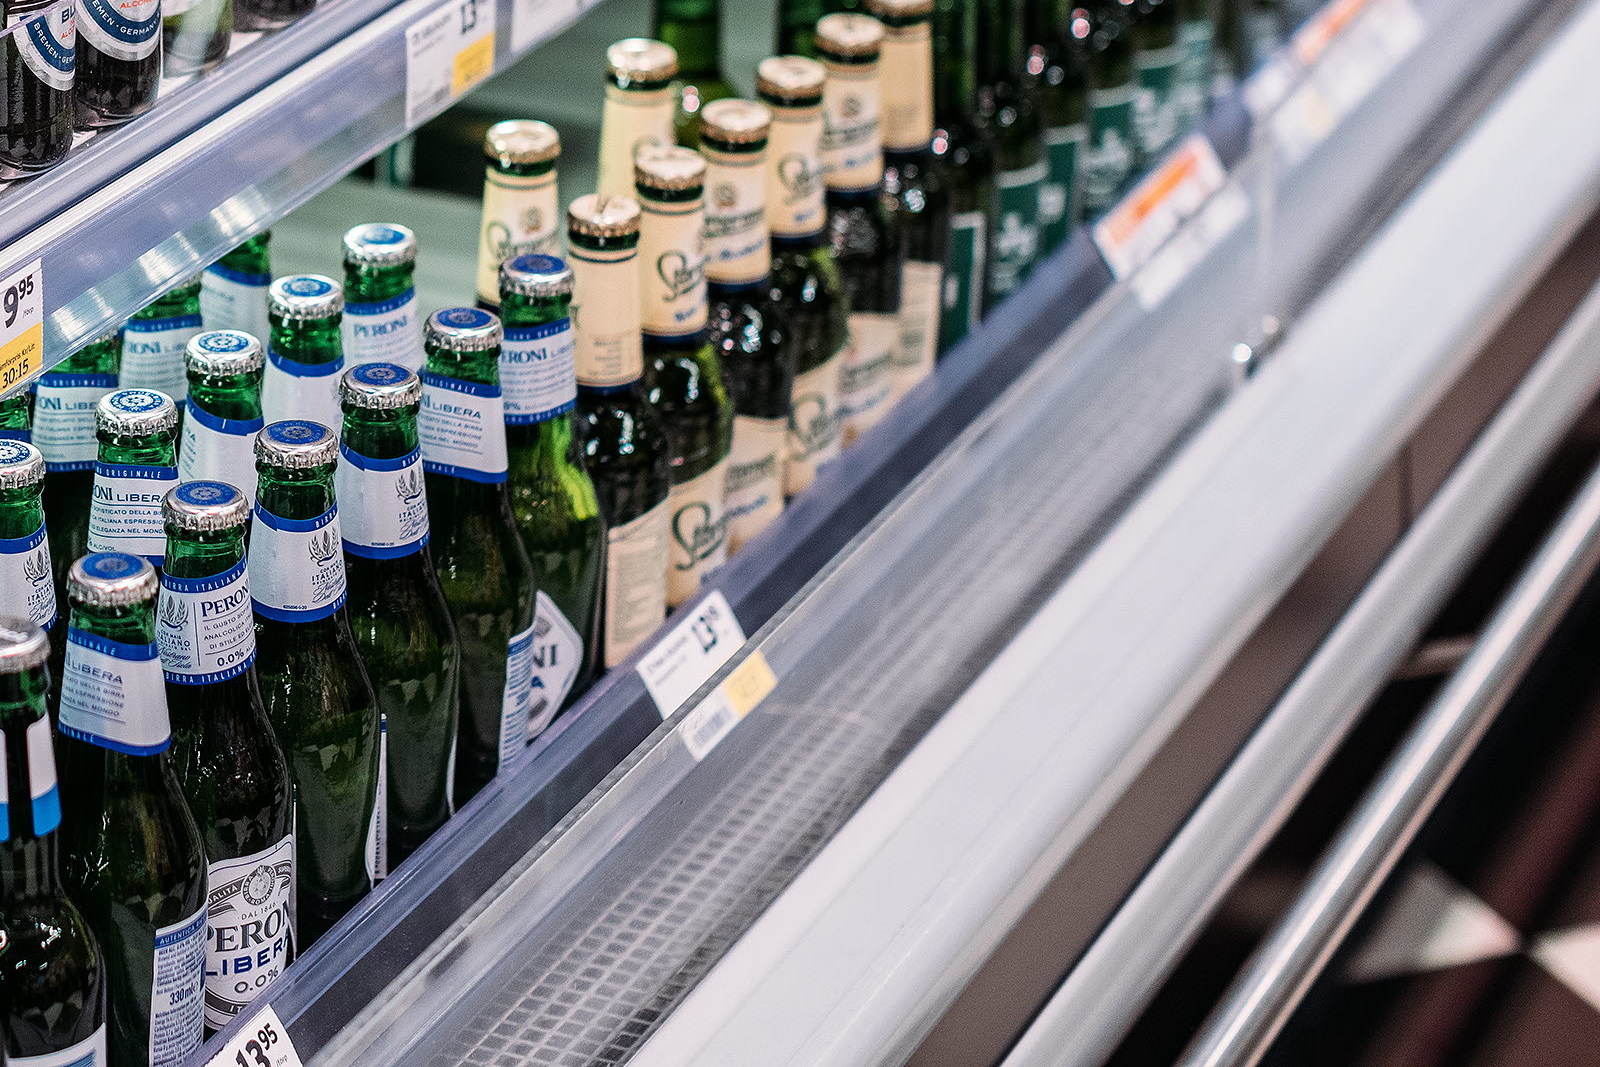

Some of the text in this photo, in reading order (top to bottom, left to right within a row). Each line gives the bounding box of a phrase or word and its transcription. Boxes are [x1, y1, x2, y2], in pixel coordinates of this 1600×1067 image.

[33, 21, 59, 60] BREMEN
[501, 346, 548, 365] ERONI
[2, 358, 30, 390] 30:15
[39, 396, 62, 410] ONI
[106, 468, 161, 479] ORIGINALE
[94, 484, 114, 501] ONI
[164, 569, 241, 592] BIRRA ITALIANA
[203, 621, 245, 641] ANALCOLICA
[212, 616, 237, 629] GUSTO
[219, 636, 237, 648] STILE
[216, 648, 245, 667] 0.0%
[71, 662, 123, 684] LIBERA
[165, 662, 248, 683] BIRRA ITALIANA
[242, 910, 258, 921] DAL
[233, 967, 279, 995] 0.0%
